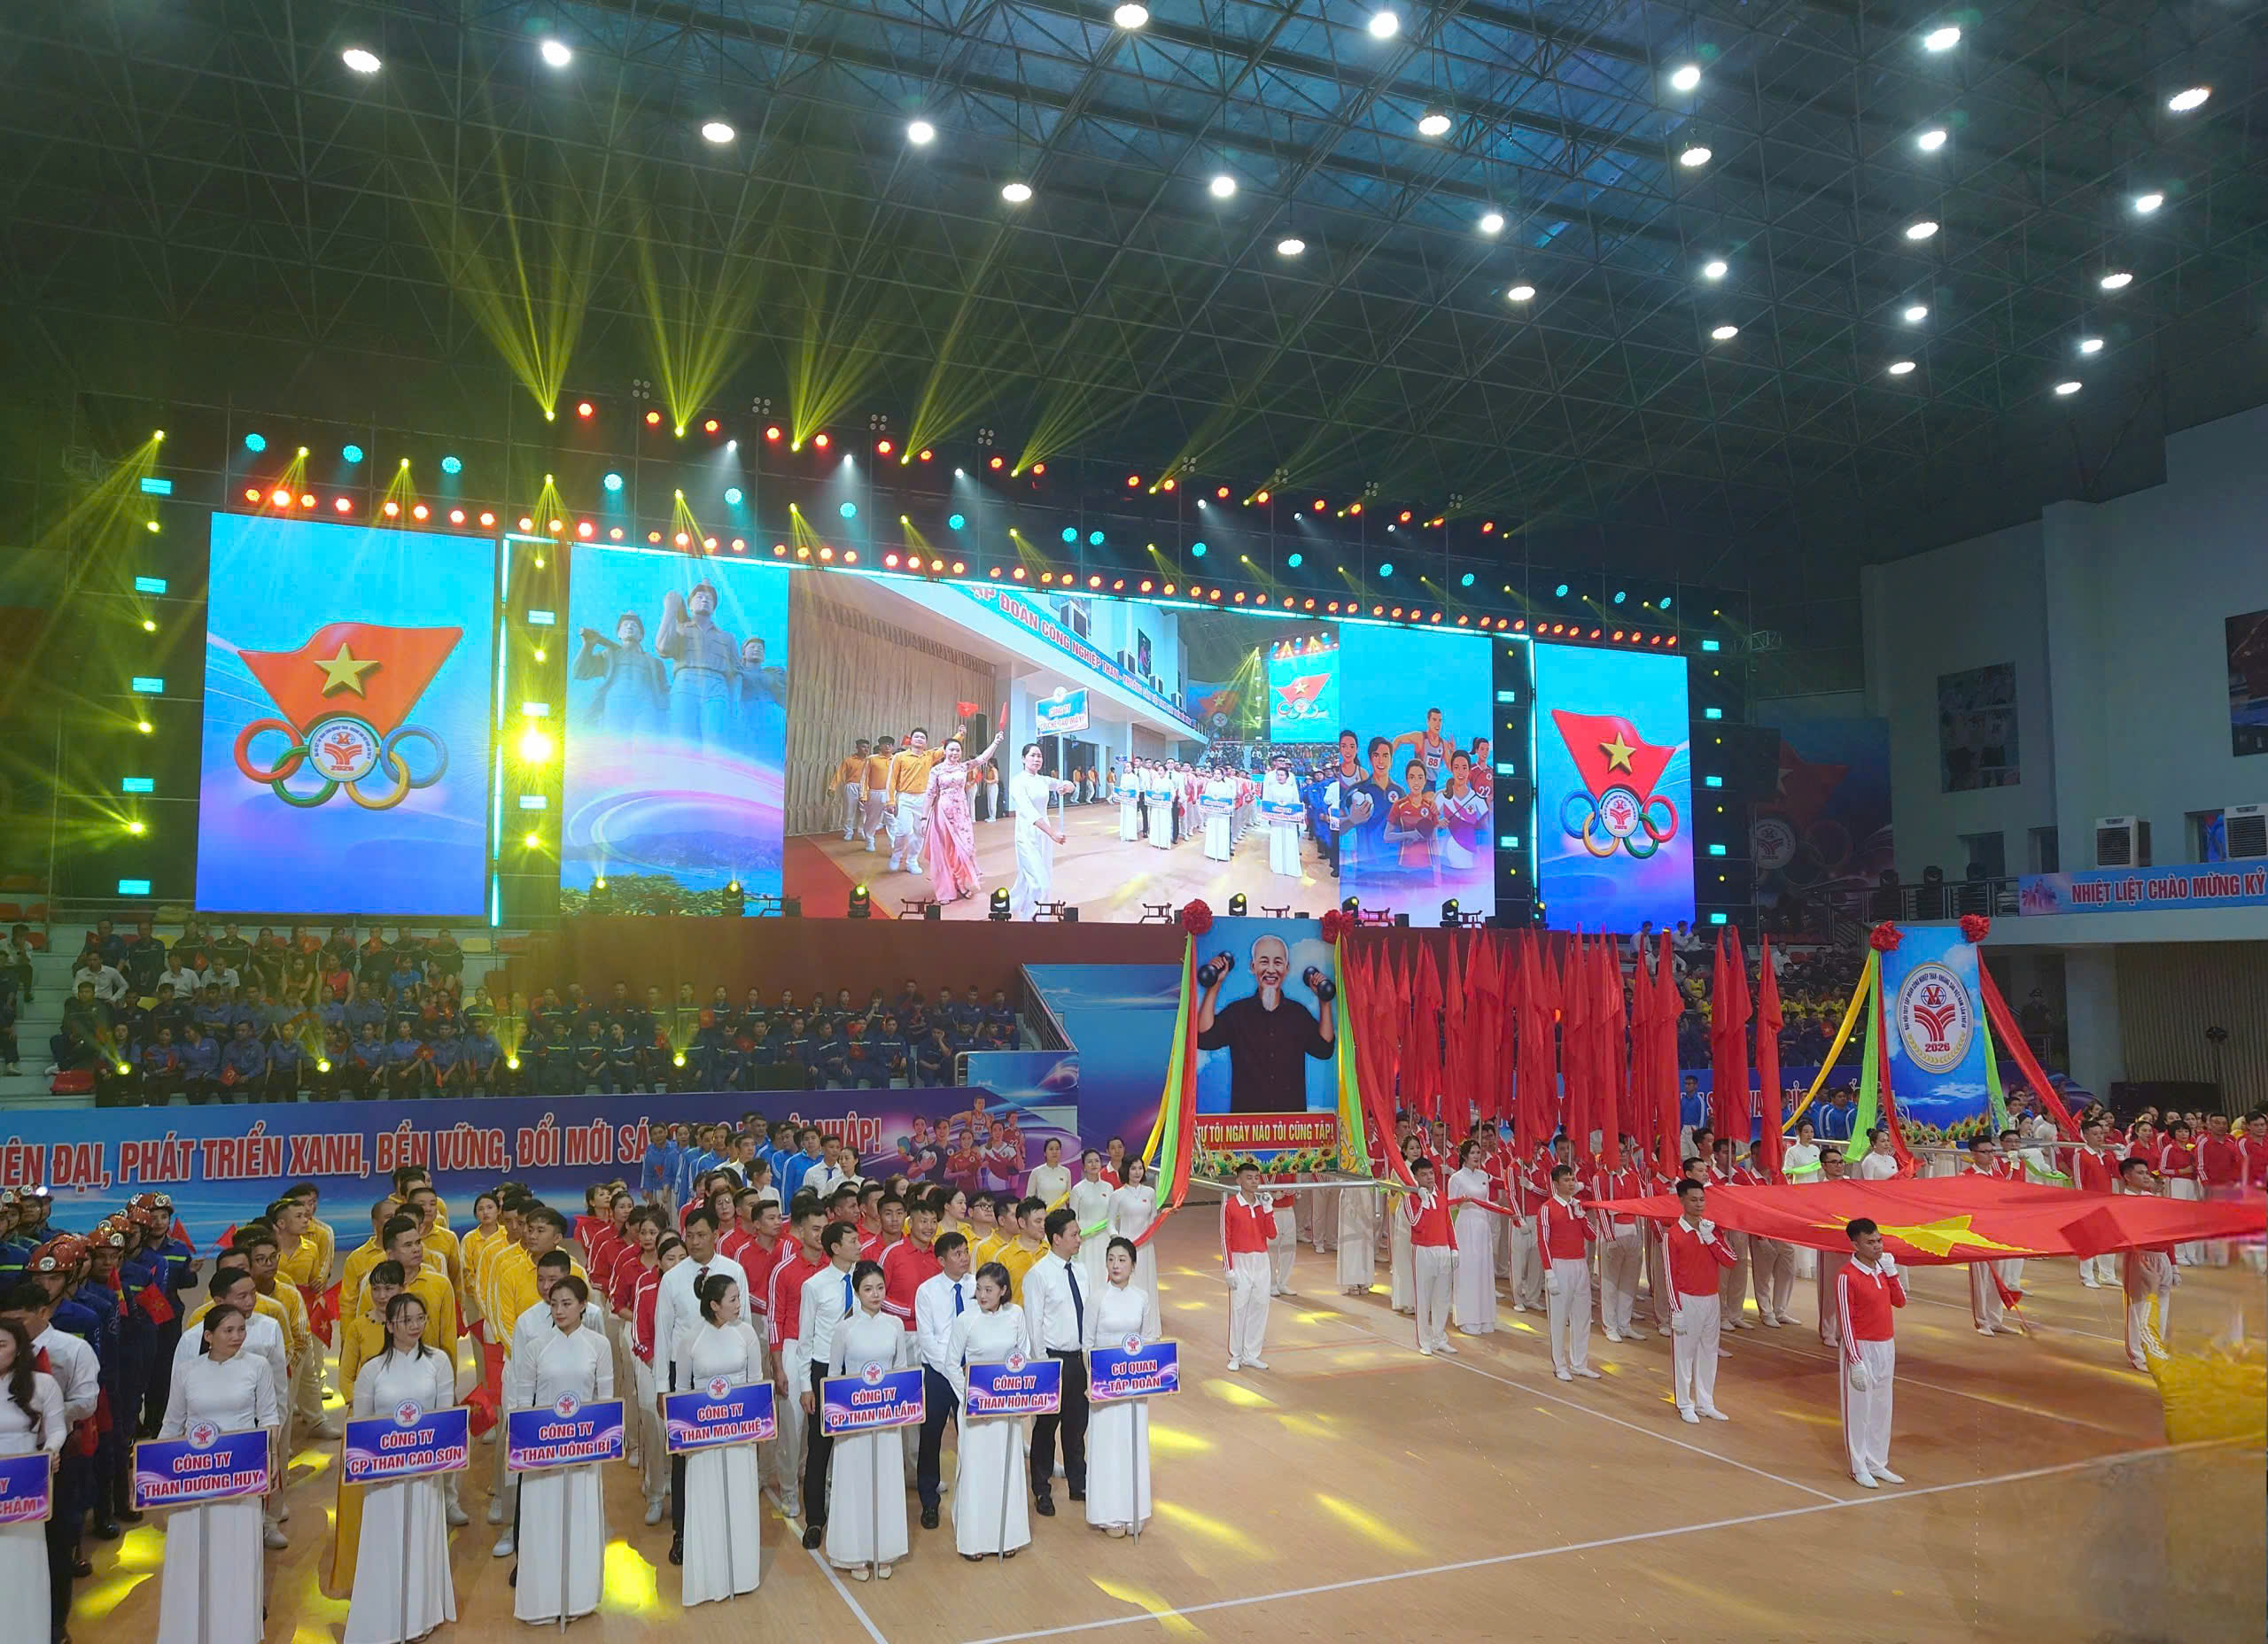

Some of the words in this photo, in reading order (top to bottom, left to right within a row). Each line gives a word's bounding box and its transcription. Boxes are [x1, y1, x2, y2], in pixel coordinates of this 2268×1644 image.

[999, 593, 1039, 630] ĐOÀN
[1041, 621, 1070, 650] CÔNG
[1072, 641, 1101, 670] NGHIỆP
[1427, 757, 1439, 767] 88
[1479, 786, 1491, 798] 22
[2071, 879, 2111, 906] NHIỆT
[2115, 877, 2145, 906] LIỆT
[2148, 874, 2188, 899] CHÀO
[2192, 872, 2241, 896] MỪNG
[2244, 865, 2267, 896] KỶ
[1925, 1043, 1951, 1052] 2026
[1209, 1122, 1223, 1143] TÔI
[1225, 1121, 1250, 1143] NGÀY
[1252, 1121, 1270, 1142] NÀO
[1272, 1121, 1286, 1141] TÔI
[1289, 1120, 1312, 1141] CŨNG
[1315, 1120, 1333, 1144] TẬP!
[51, 1141, 111, 1192] ĐẠI,
[119, 1131, 196, 1183] PHÁT
[201, 1120, 284, 1180] TRIỂN
[288, 1133, 369, 1178] XANH,
[377, 1120, 431, 1173] BỀN
[437, 1122, 511, 1173] VỮNG,
[517, 1113, 560, 1167] ĐỔI
[565, 1118, 611, 1165] MỚI
[1112, 1361, 1127, 1376] CƠ
[1129, 1360, 1157, 1375] QUAN
[994, 1375, 1021, 1391] CÔNG
[1023, 1376, 1037, 1389] TY
[1108, 1378, 1129, 1394] TẬP
[851, 1389, 882, 1405] CÔNG
[883, 1387, 897, 1400] TY
[978, 1396, 1006, 1410] THAN
[1030, 1394, 1048, 1407] GAI
[697, 1405, 728, 1422] CÔNG
[729, 1403, 743, 1417] TY
[830, 1414, 846, 1427] CP
[848, 1408, 875, 1424] THAN
[878, 1403, 893, 1420] HÀ
[380, 1431, 416, 1450] CÔNG
[418, 1429, 435, 1445] TY
[540, 1423, 575, 1440] CÔNG
[578, 1421, 594, 1437] TY
[681, 1427, 710, 1443] THAN
[712, 1423, 738, 1438] MẠO
[740, 1417, 762, 1434] KHÊ
[522, 1446, 555, 1462] THAN
[558, 1441, 594, 1458] UÔNG
[597, 1438, 610, 1454] BÍ
[174, 1454, 212, 1472] CÔNG
[214, 1452, 232, 1467] TY
[350, 1460, 369, 1476] CP
[371, 1454, 405, 1471] THAN
[408, 1450, 433, 1466] CAO
[436, 1446, 462, 1462] SƠN
[0, 1477, 10, 1494] Y
[144, 1479, 181, 1500] THAN
[183, 1474, 231, 1493] DƯƠNG
[233, 1470, 260, 1487] HUY
